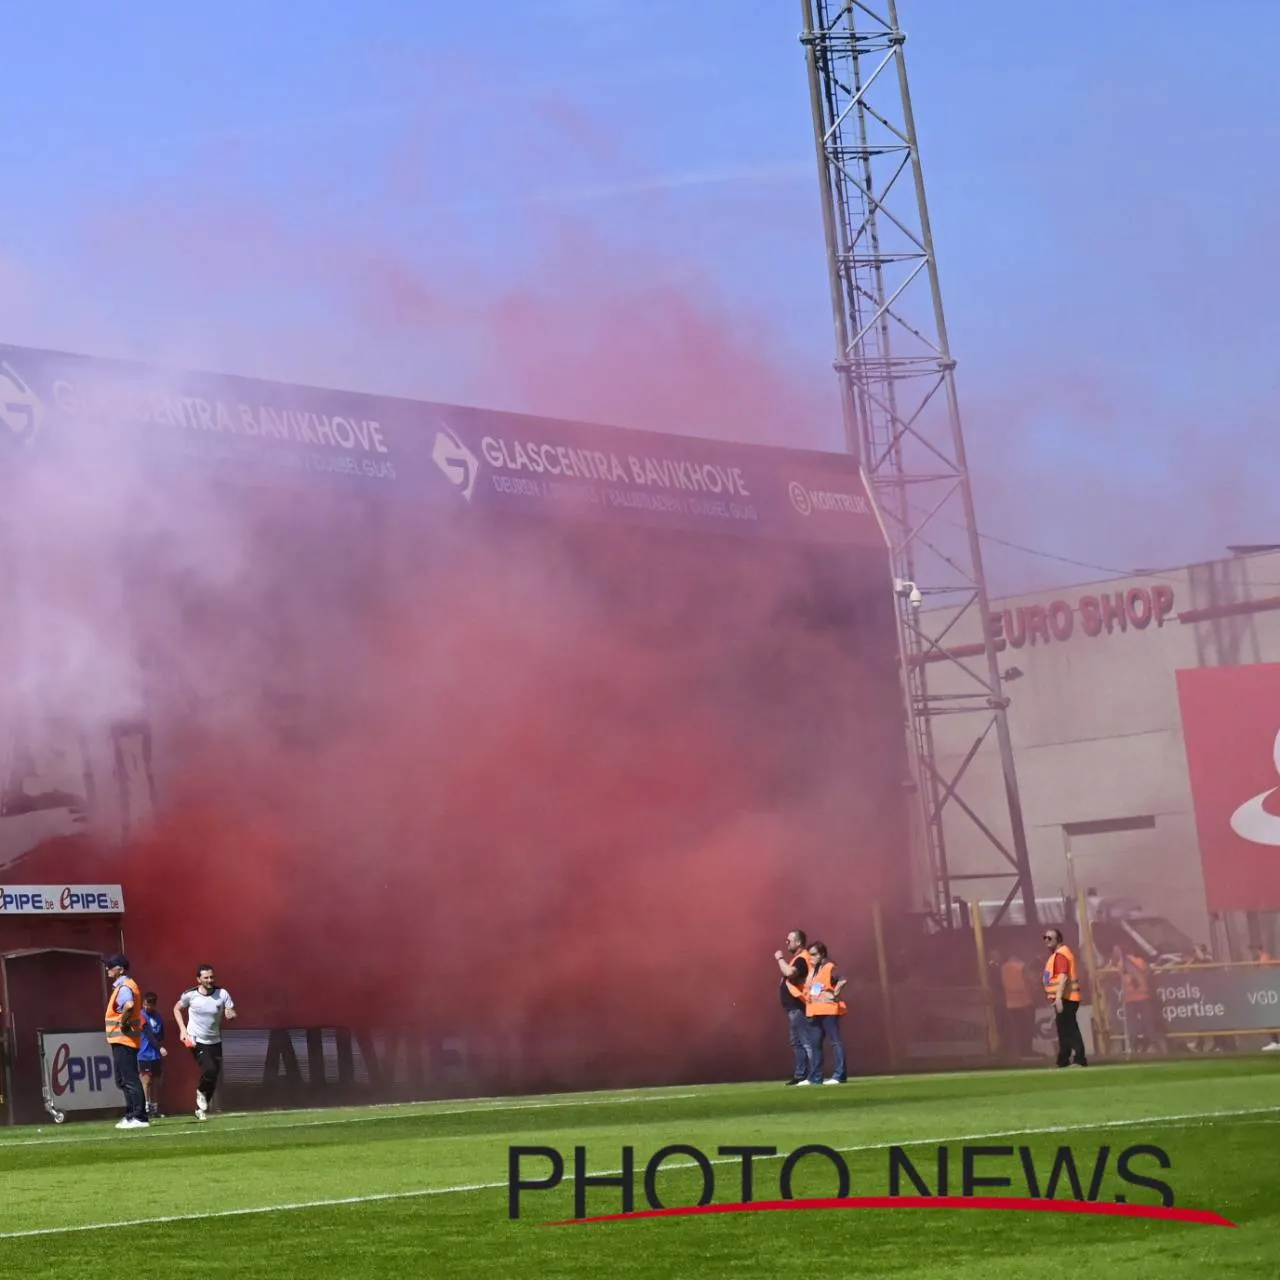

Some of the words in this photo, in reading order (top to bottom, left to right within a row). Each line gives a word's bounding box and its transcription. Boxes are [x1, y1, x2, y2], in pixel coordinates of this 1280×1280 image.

[239, 404, 388, 453] BAVIKHOVE
[481, 436, 630, 483] GLASCENTRA
[628, 454, 750, 496] BAVIKHOVE
[988, 599, 1074, 653] EURO
[1078, 584, 1175, 638] SHOP
[1247, 990, 1278, 1006] VGD
[51, 1043, 113, 1097] ePIP
